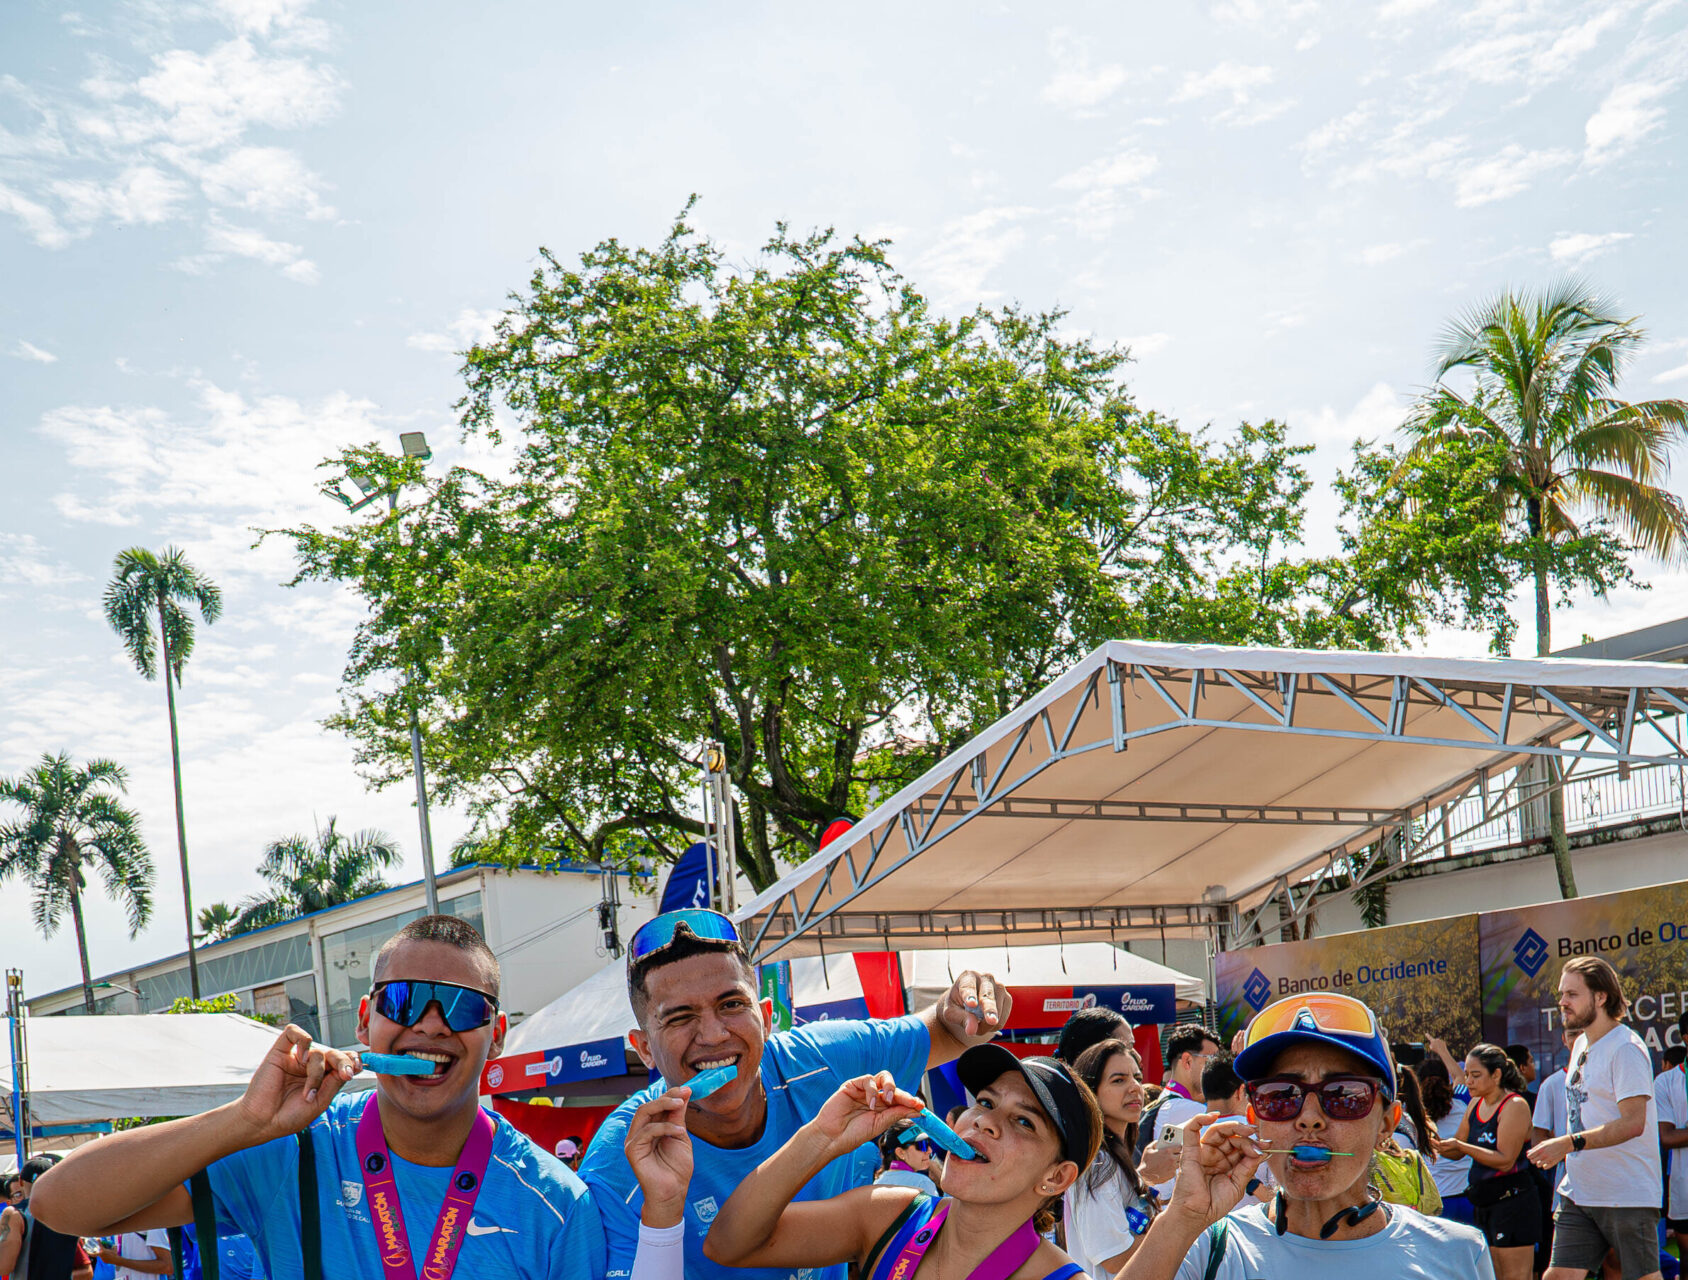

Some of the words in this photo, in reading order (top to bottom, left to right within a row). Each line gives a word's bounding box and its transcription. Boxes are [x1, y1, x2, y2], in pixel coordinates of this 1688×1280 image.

[1557, 934, 1621, 958] Banco
[1627, 927, 1653, 947] de
[1278, 975, 1329, 995] Banco
[1332, 969, 1354, 987] de
[1357, 958, 1448, 984] Occidente
[1045, 1000, 1080, 1010] TERRITORIO
[374, 1192, 399, 1250] MARATÓN
[432, 1206, 460, 1265] MARATÓN
[606, 1269, 630, 1278] CALI
